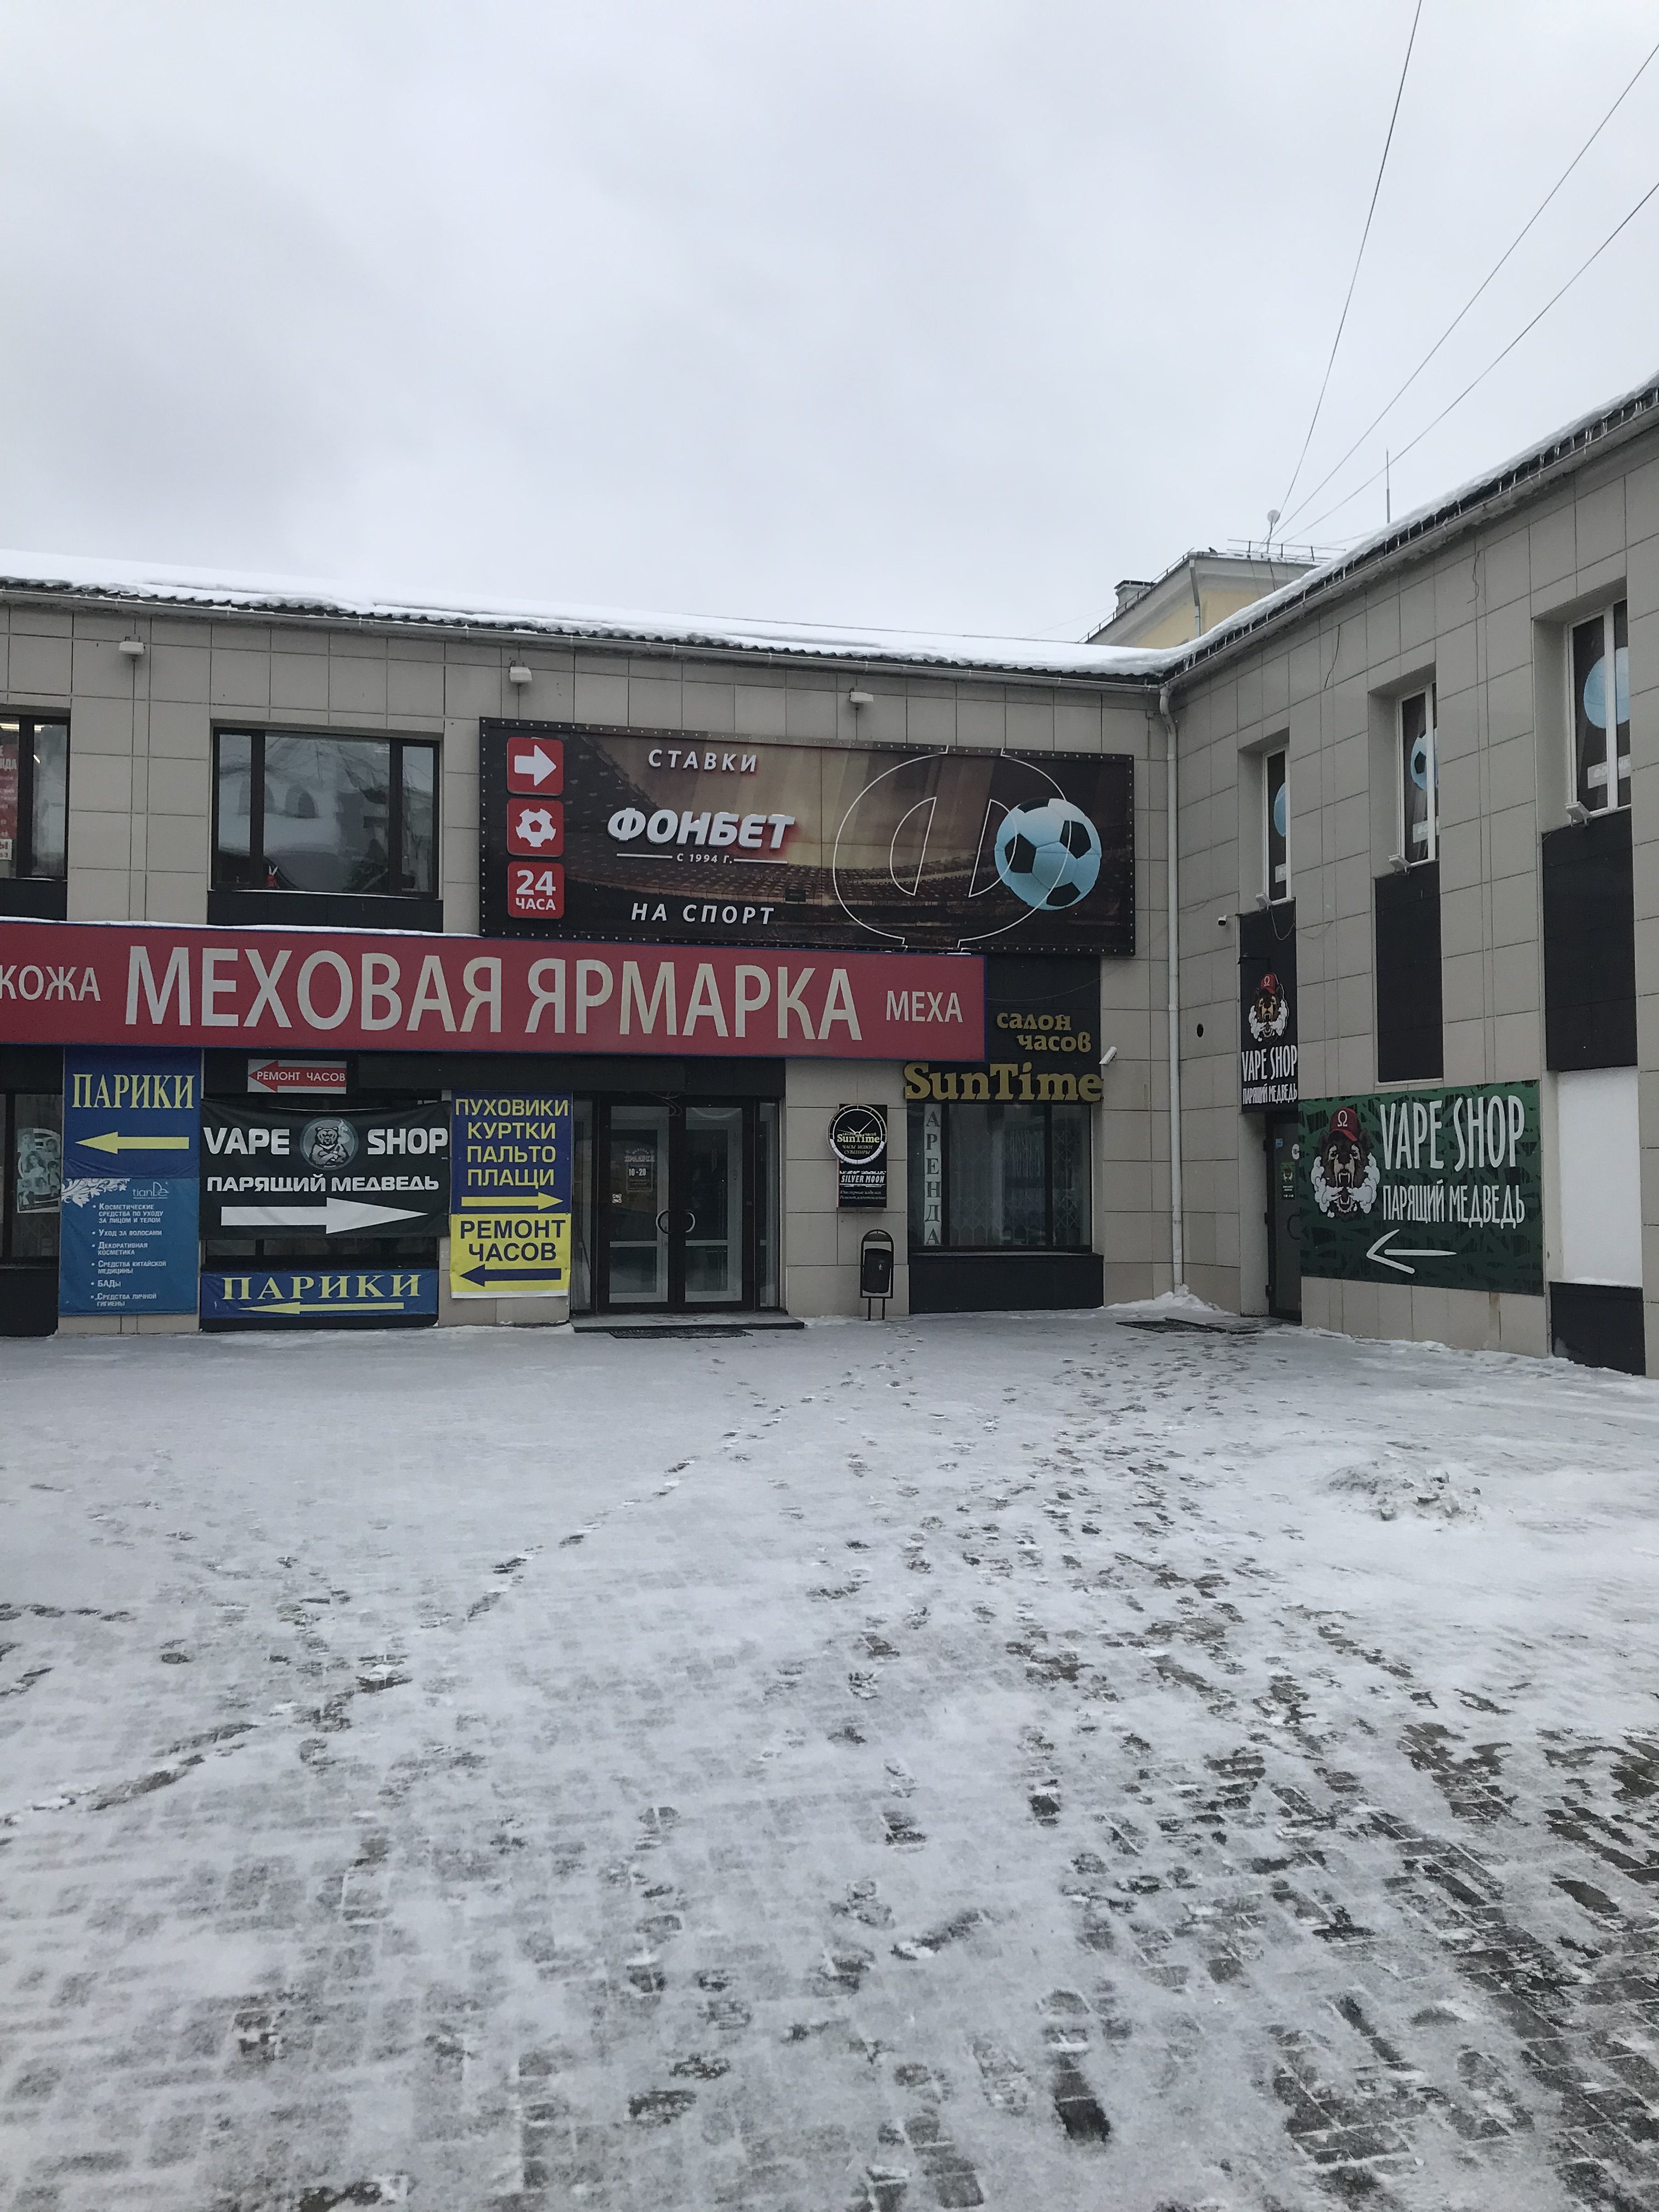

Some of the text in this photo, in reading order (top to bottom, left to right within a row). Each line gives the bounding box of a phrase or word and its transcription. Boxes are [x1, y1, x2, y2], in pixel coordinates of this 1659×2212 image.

[648, 749, 757, 772] СТАВКИ
[607, 807, 795, 849] ФОНБЕТ
[689, 853, 718, 864] 1994
[516, 870, 556, 896] 24
[516, 898, 556, 911] ЧАСА
[631, 902, 774, 925] НА СПОРТ
[0, 945, 963, 1041] КОЖА МЕХОВАЯ ЯРМАРКА МЕХА
[997, 1012, 1071, 1031] салон
[1017, 1031, 1091, 1052] часов
[1242, 1045, 1297, 1082] VAPE SHOP
[257, 1071, 346, 1082] РЕМОНТ ЧАСОВ
[904, 1062, 1103, 1102] SunTime
[72, 1074, 195, 1109] ПАРИКИ
[1268, 1082, 1297, 1105] МЕДВЕДЬ
[455, 1099, 569, 1116] ПУХОВИКИ
[203, 1127, 448, 1155] VAPE SHOP
[468, 1122, 556, 1139] КУРТКИ
[837, 1133, 880, 1143] SunTime
[1380, 1095, 1525, 1172] VAPE SHOP
[467, 1146, 556, 1163] ПАЛЬТО
[207, 1173, 439, 1192] ПАРЯЩИЙ МЕДВЕДЬ
[467, 1169, 554, 1189] ПЛАЩИ
[865, 1175, 885, 1183] MOON
[925, 1111, 942, 1245] АРЕНДА
[1383, 1180, 1525, 1229] ПАРЯЩИЙ МЕДВЕДЬ
[460, 1220, 566, 1239] РЕМОНТ
[469, 1243, 557, 1262] ЧАСОВ
[222, 1274, 421, 1300] ПАРИКИ
